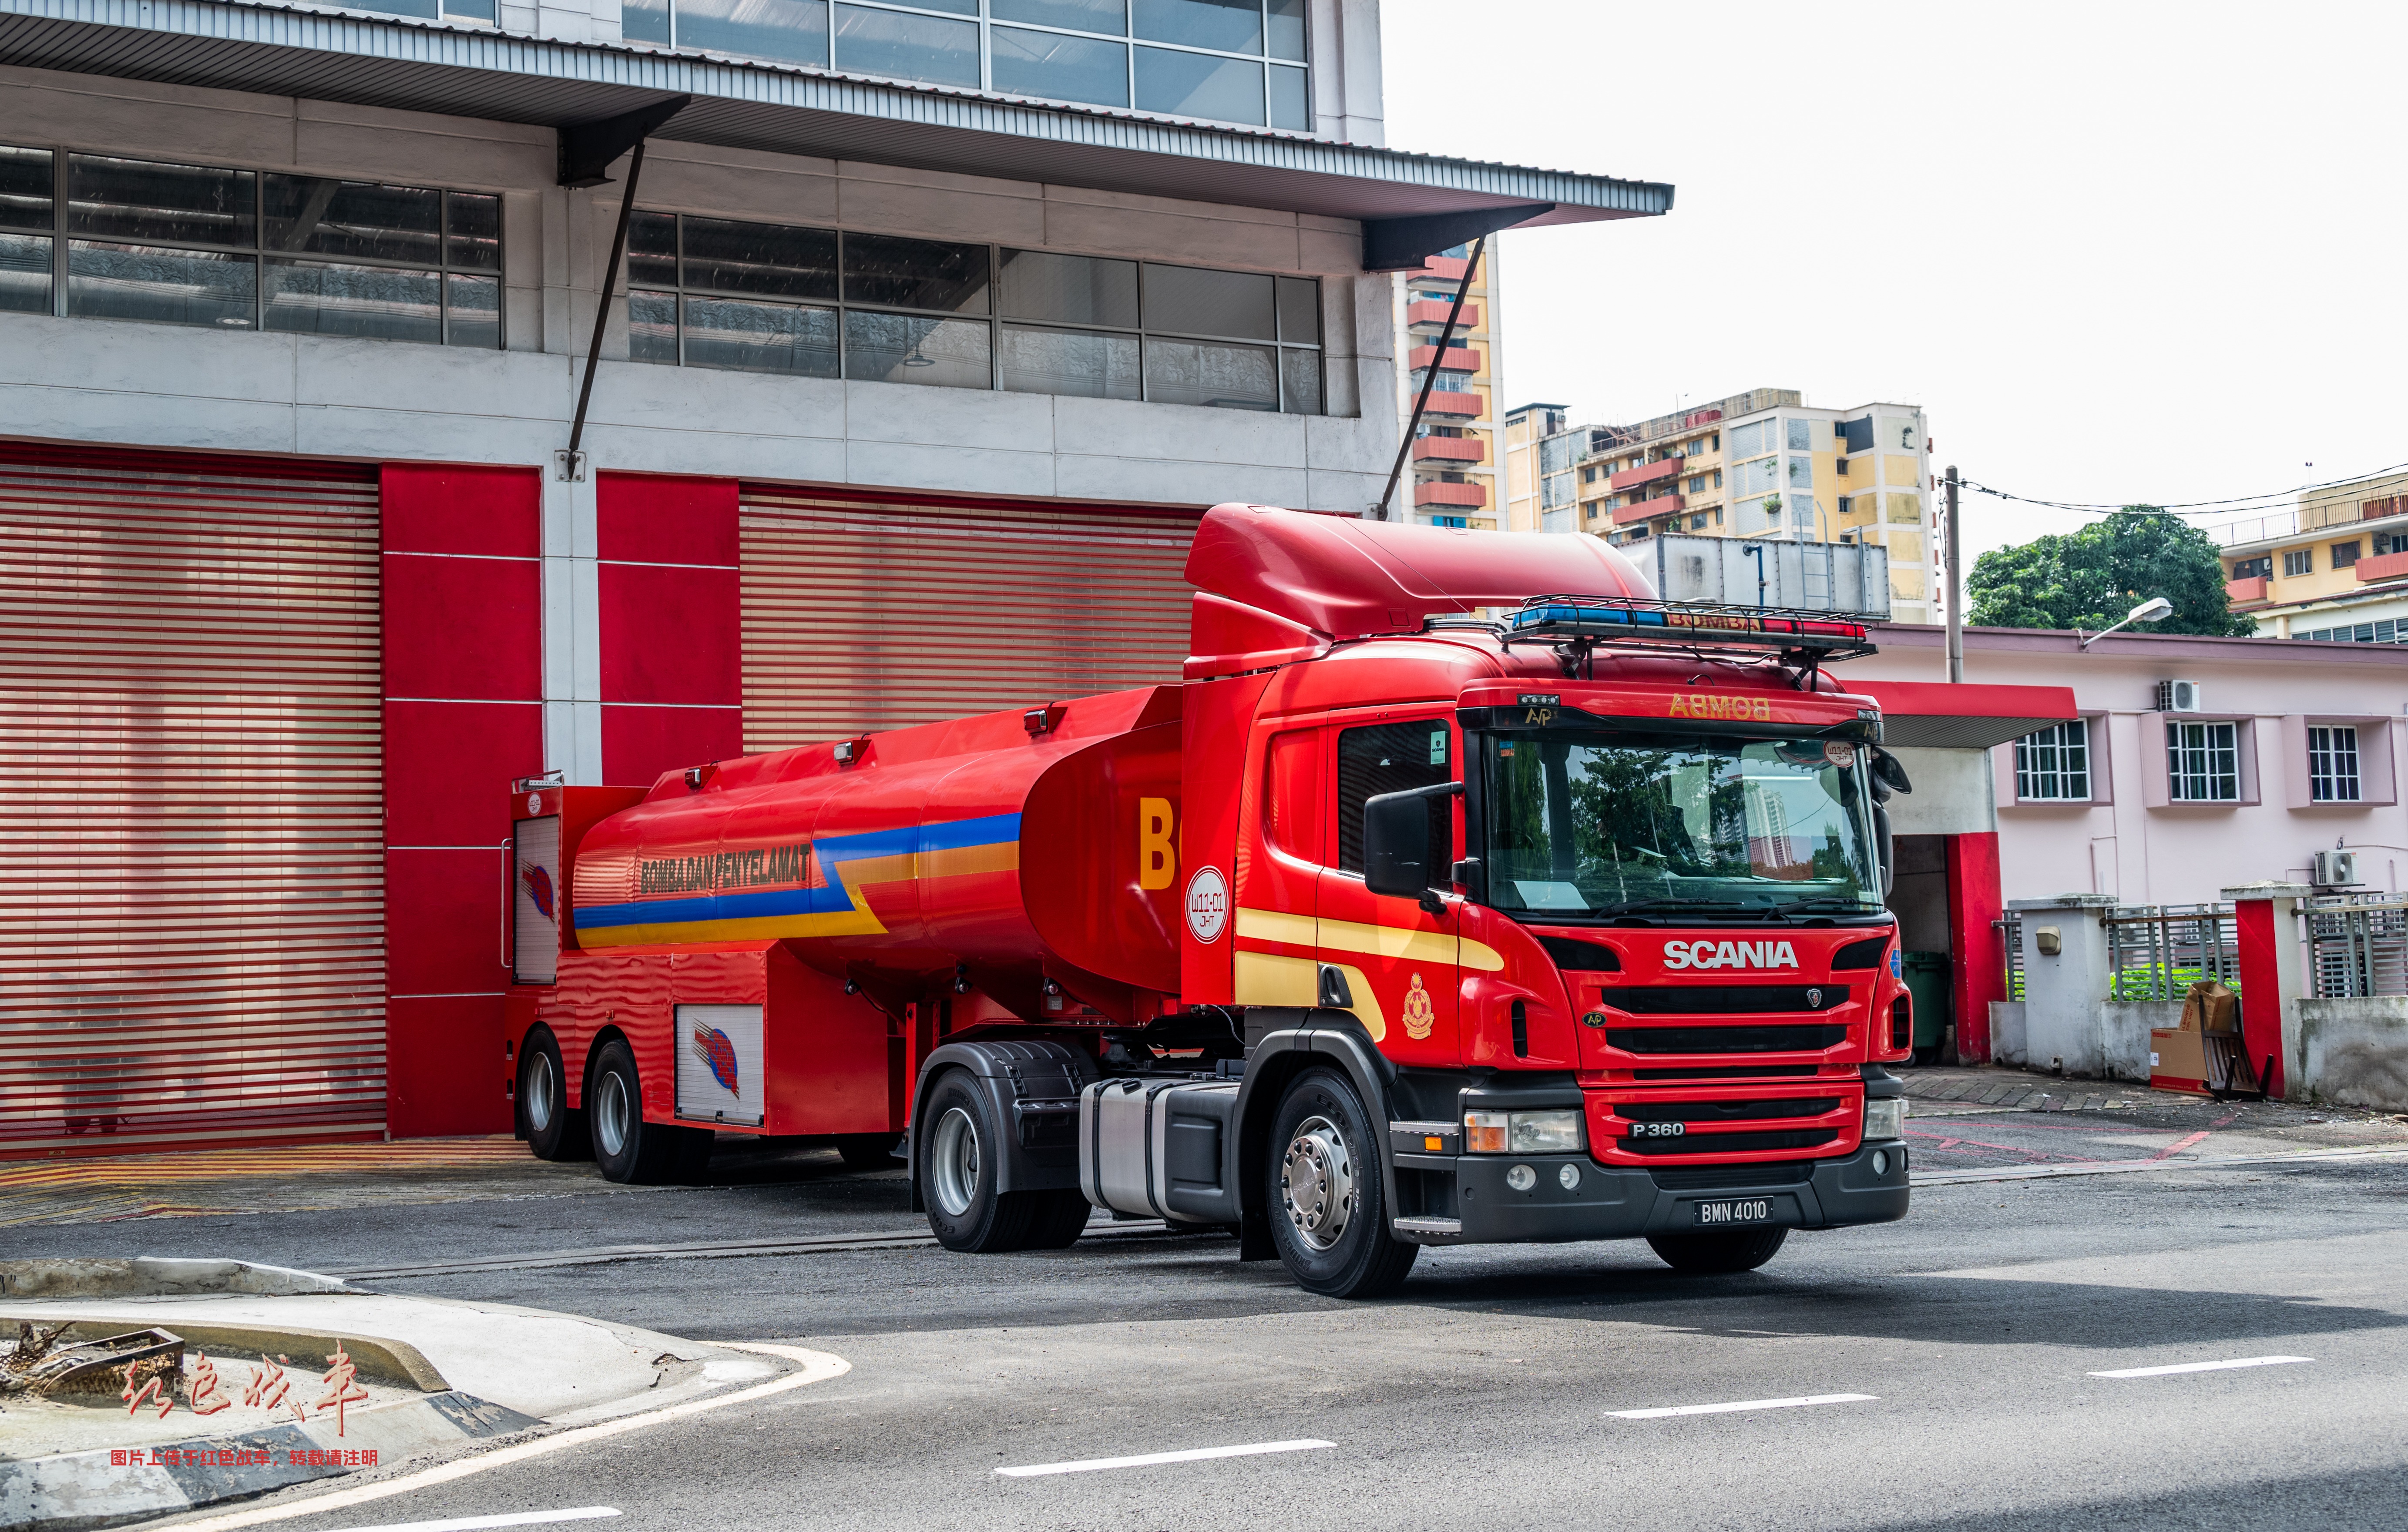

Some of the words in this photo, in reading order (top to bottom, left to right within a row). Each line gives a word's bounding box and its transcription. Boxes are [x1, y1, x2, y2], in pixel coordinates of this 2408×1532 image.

[1669, 613, 1759, 630] BOMBA
[1827, 746, 1853, 755] W11-01
[1140, 797, 1182, 890] B
[641, 858, 684, 894] BOMBA
[686, 855, 714, 891] DAN
[715, 843, 810, 888] PENYELAMAT
[1192, 892, 1223, 912] W11-01
[1200, 916, 1214, 927] JHT
[1663, 940, 1800, 969] SCANIA
[1317, 1093, 1360, 1177] ECOPIA
[1633, 1125, 1645, 1136] P
[1648, 1123, 1684, 1136] 360
[1702, 1203, 1730, 1222] BMN
[1734, 1201, 1766, 1220] 4010
